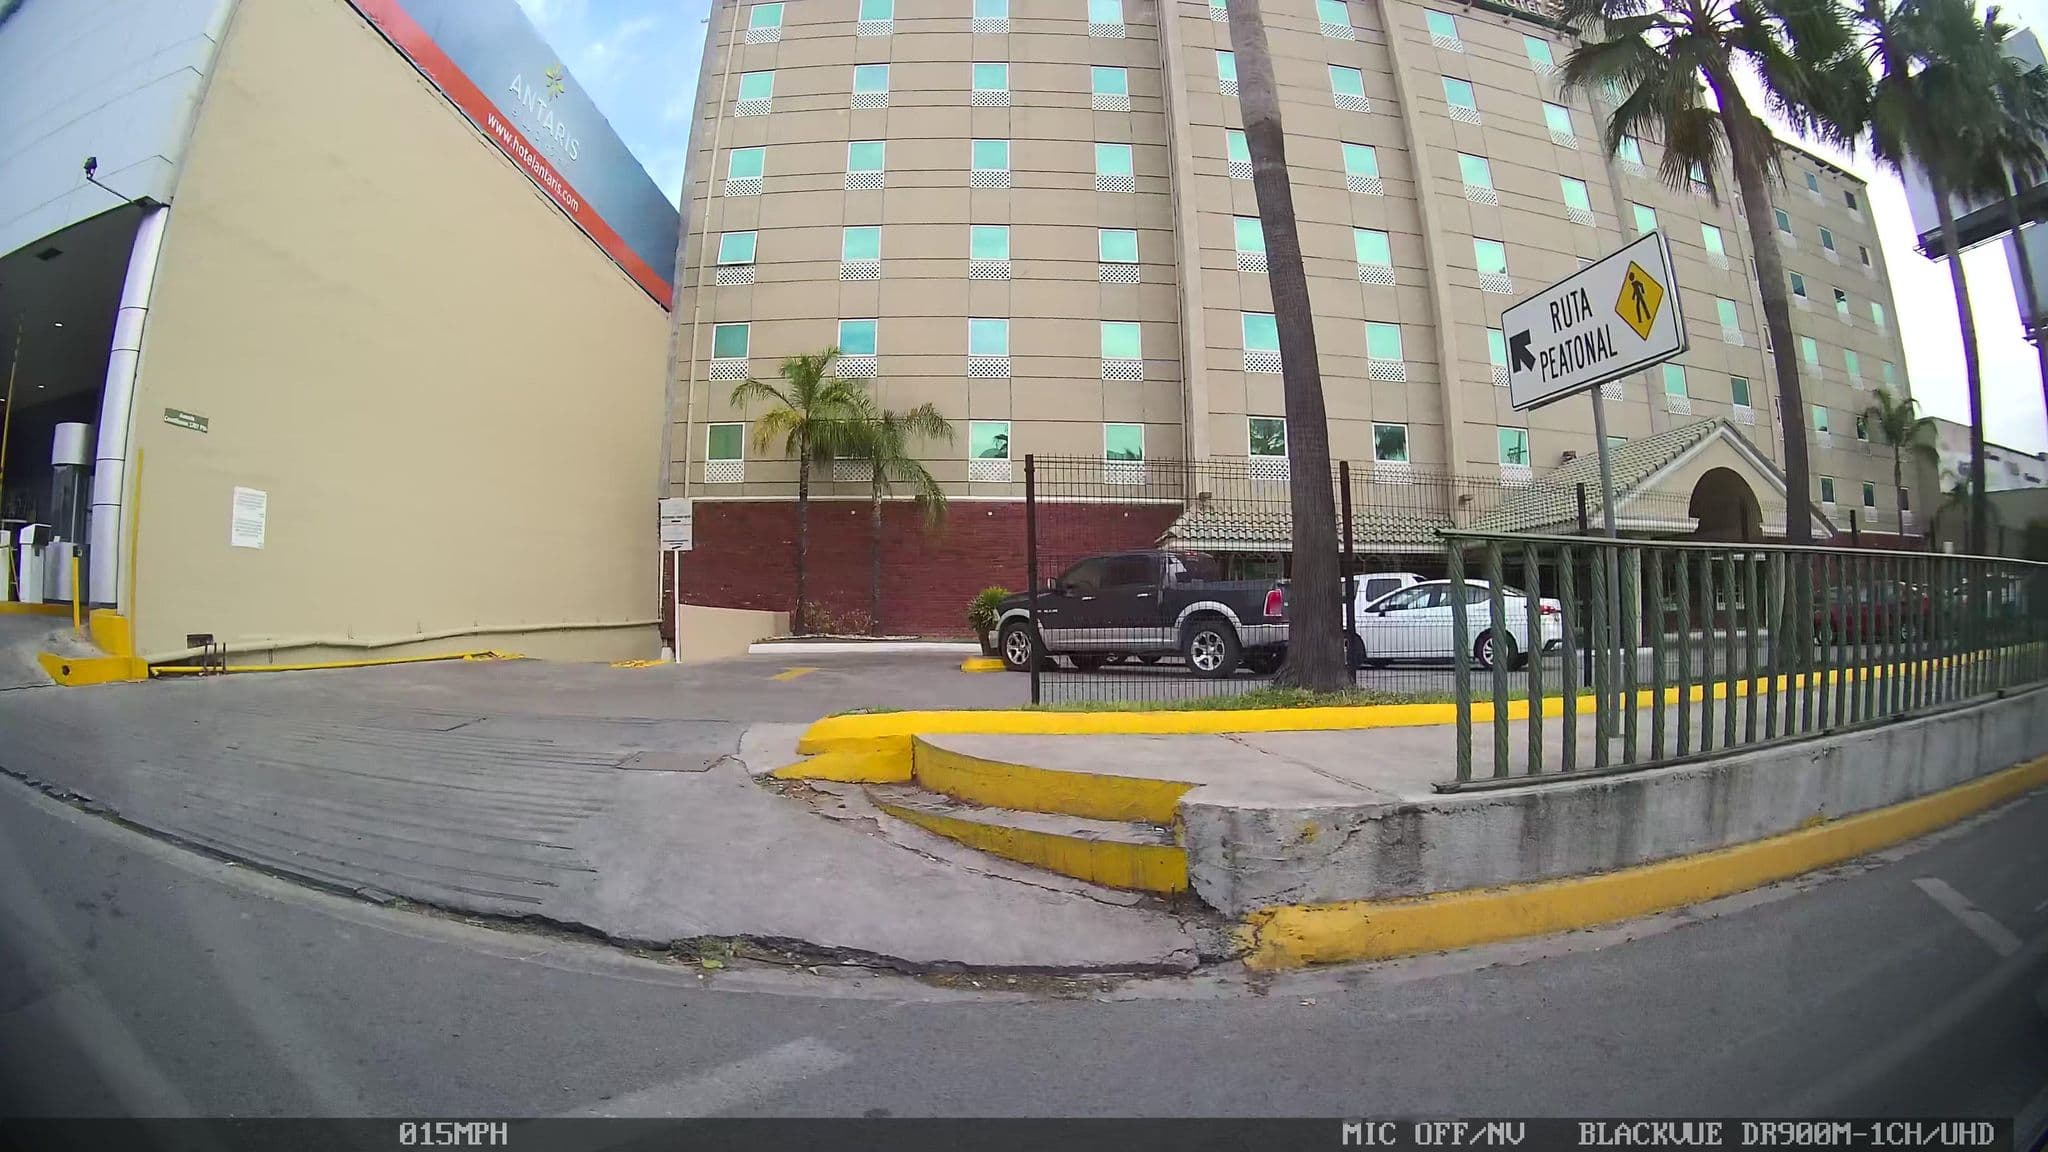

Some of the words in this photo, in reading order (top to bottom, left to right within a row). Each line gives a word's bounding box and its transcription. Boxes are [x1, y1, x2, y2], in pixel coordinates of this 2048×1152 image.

[508, 73, 580, 161] ANTARIS
[486, 112, 580, 212] www.hotelantaris.com
[1549, 286, 1593, 334] RUTA
[1539, 323, 1619, 383] PEATONAL
